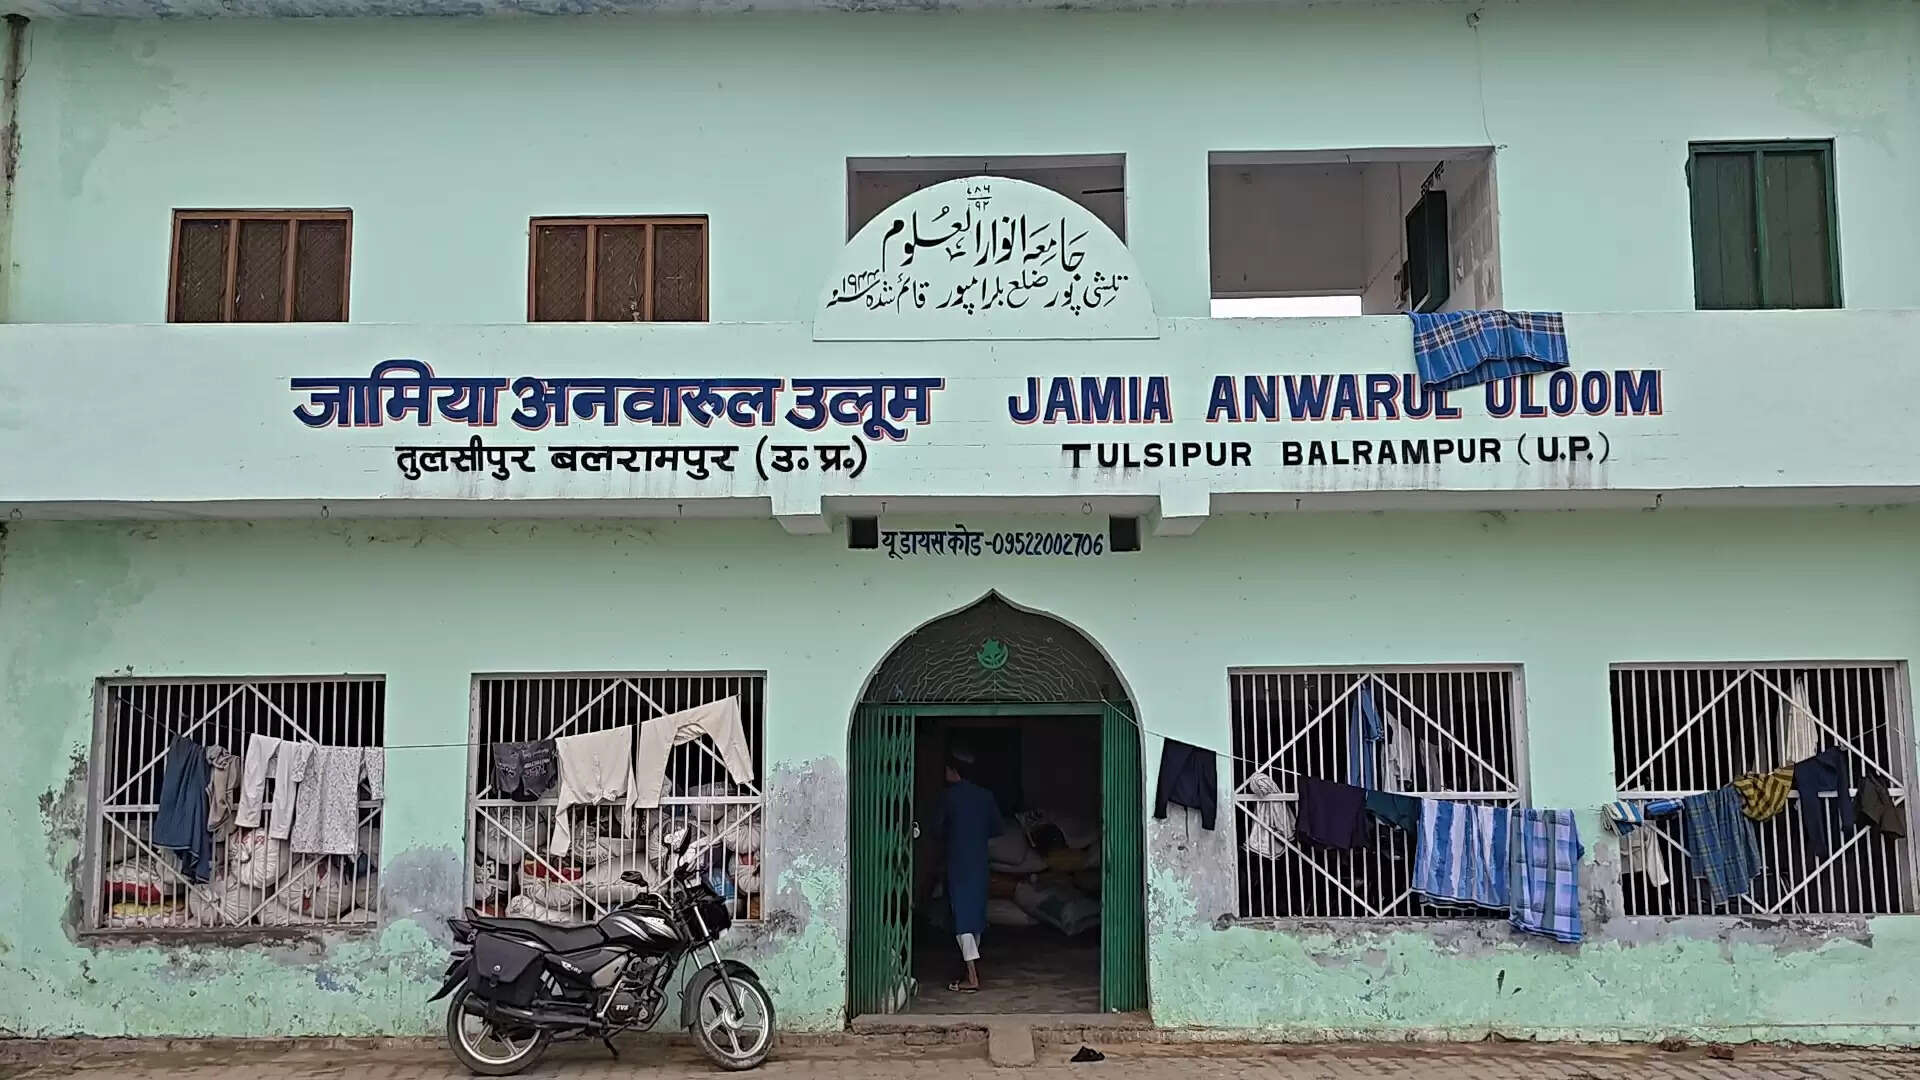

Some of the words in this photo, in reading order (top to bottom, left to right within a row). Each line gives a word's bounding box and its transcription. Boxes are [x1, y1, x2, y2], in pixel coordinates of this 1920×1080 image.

[290, 359, 511, 428] जामिया
[511, 376, 785, 431] अनवारुल
[785, 377, 945, 441] उलूम
[1008, 376, 1173, 425] JAMIA
[1206, 371, 1463, 423] ANWARUL
[1484, 369, 1663, 419] ULOOM
[394, 434, 536, 481] तुलसीपुर
[548, 445, 739, 480] बलरामपुर
[1062, 442, 1252, 469] TULSIPUR
[1283, 439, 1501, 466] BALRAMPUR
[1517, 433, 1610, 466] (U.P.)
